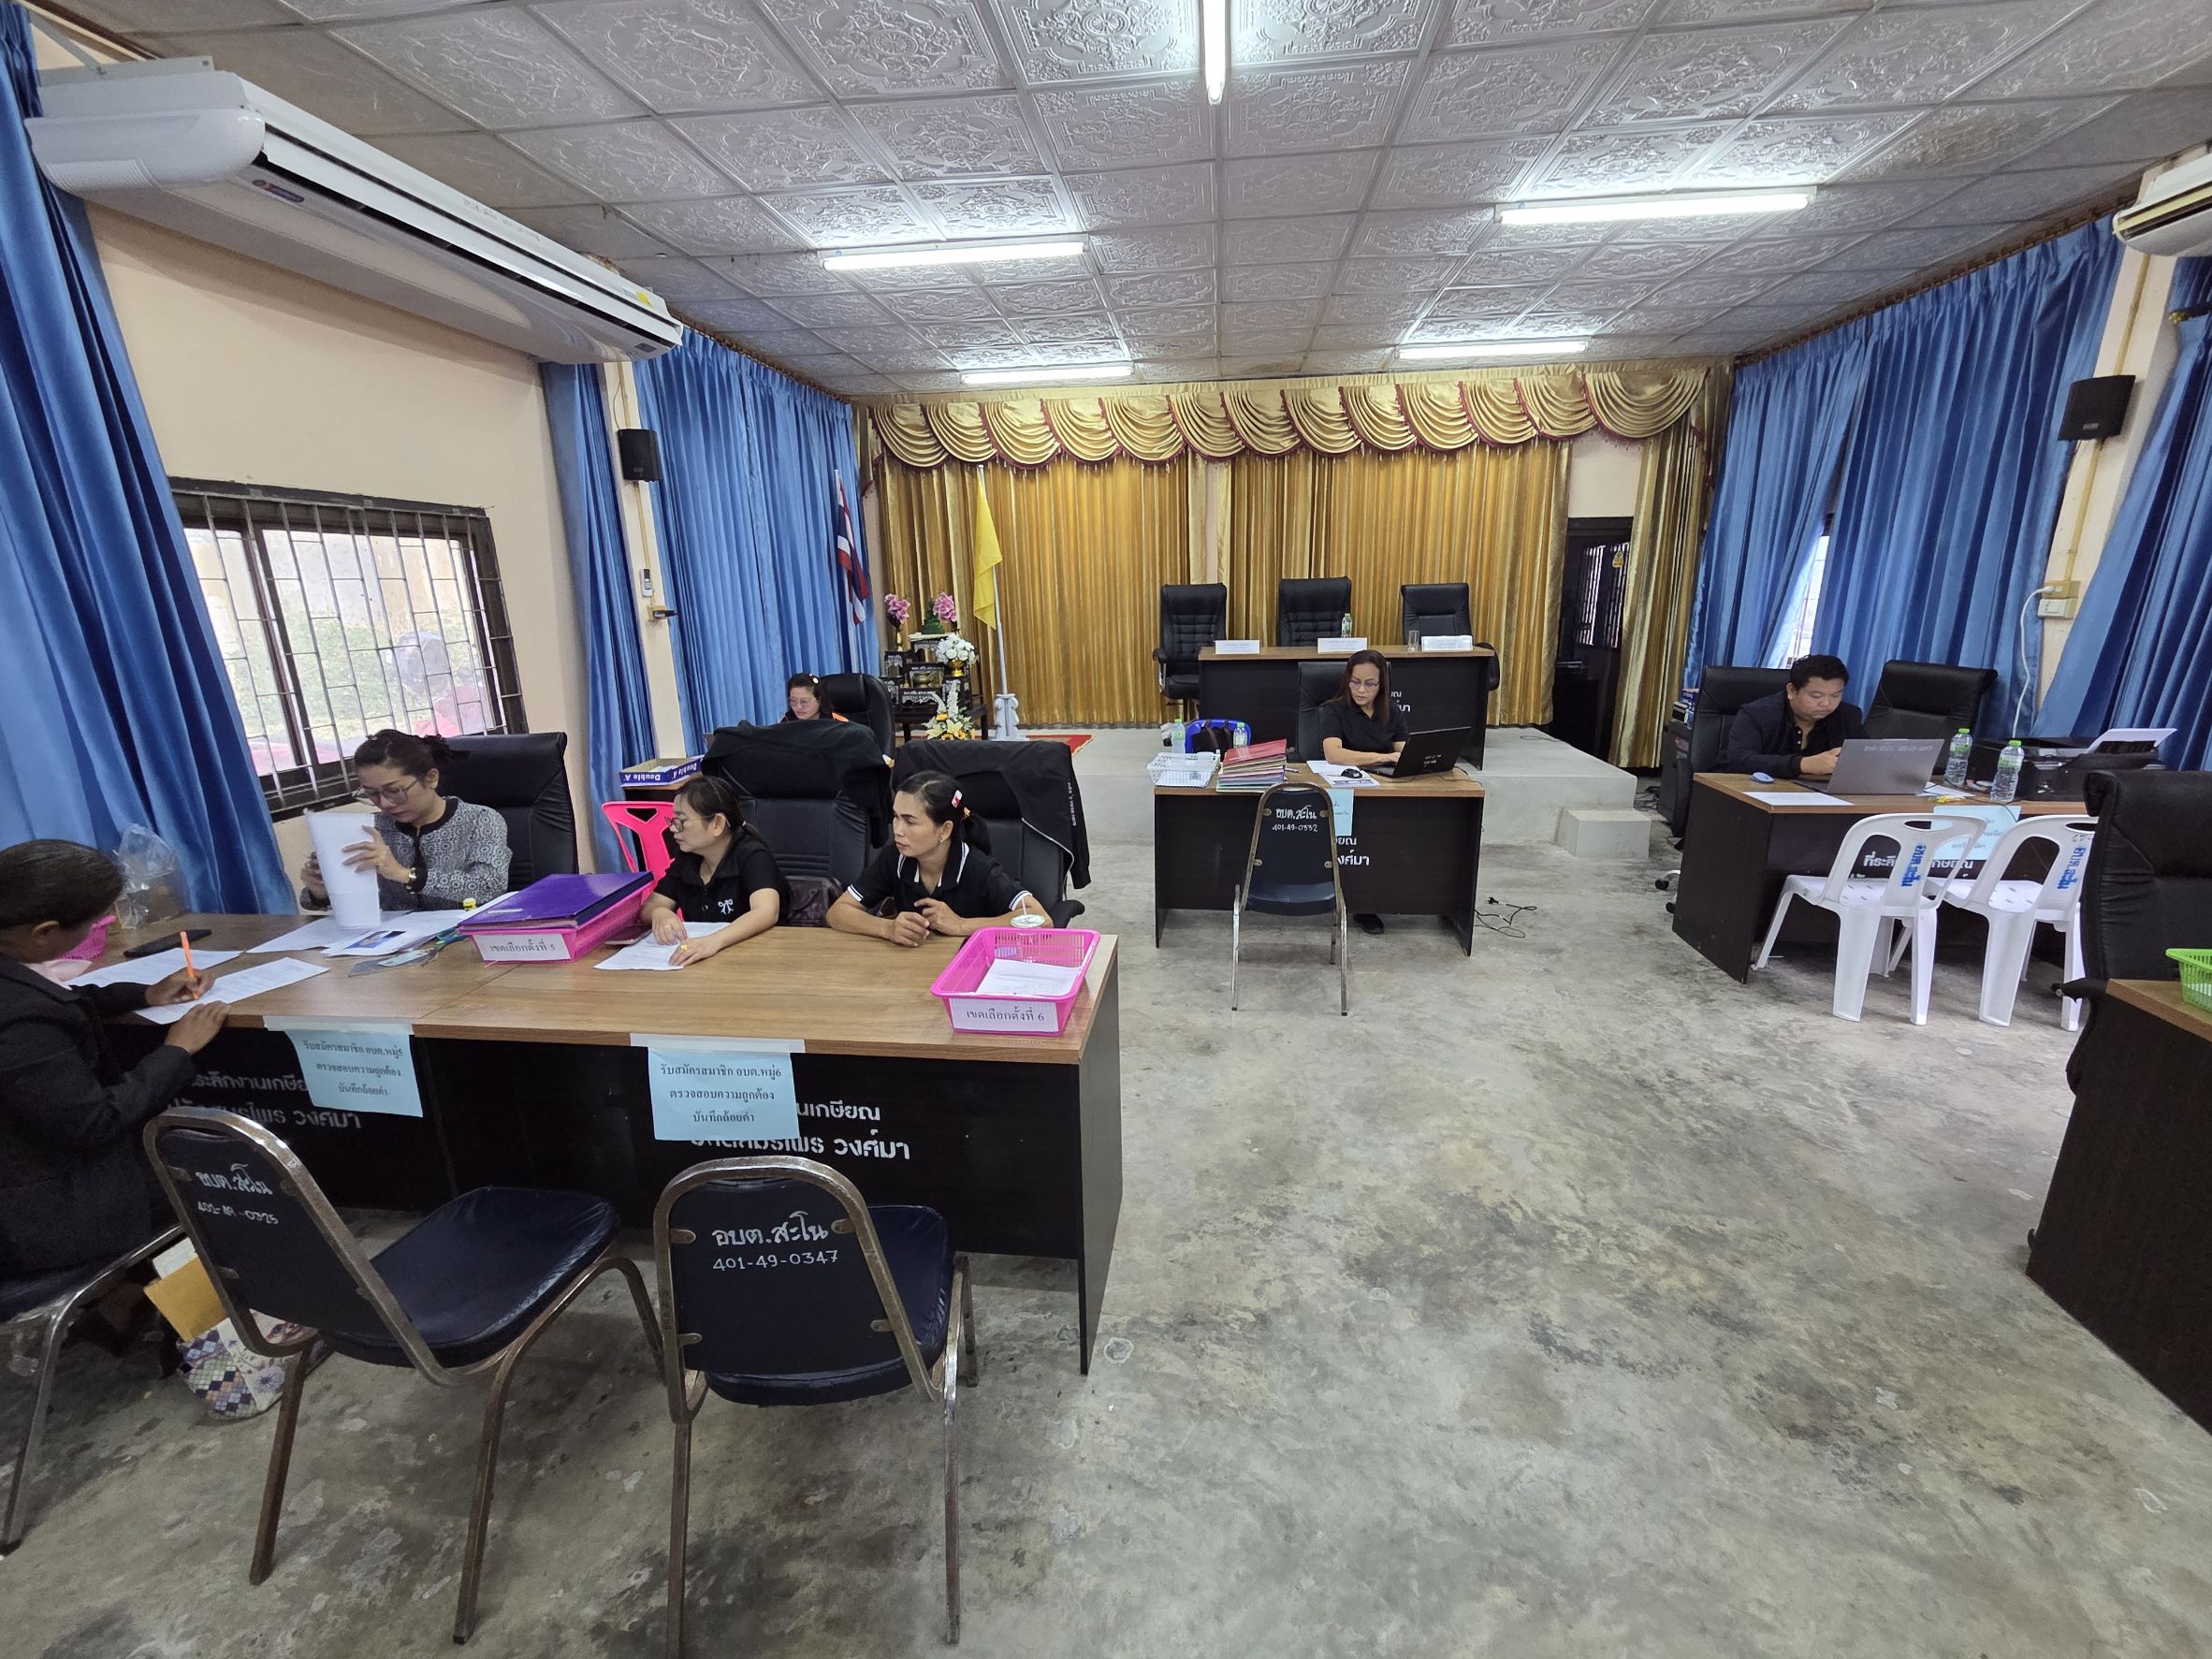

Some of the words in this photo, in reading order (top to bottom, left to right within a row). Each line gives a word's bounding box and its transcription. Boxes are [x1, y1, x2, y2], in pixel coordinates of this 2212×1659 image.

[1337, 849, 1370, 866] งศ์มา
[966, 1006, 1034, 1021] เขตเลือกตั้งที่
[1038, 1013, 1045, 1022] 6
[660, 1063, 734, 1076] รับสมัครสมาชิก
[669, 1087, 775, 1103] ตรวจสอบความถูกต้อง
[834, 1128, 910, 1160] วงศ์มา
[711, 1210, 829, 1246] อบต.สะโน
[712, 1249, 838, 1272] 401-49-0347
